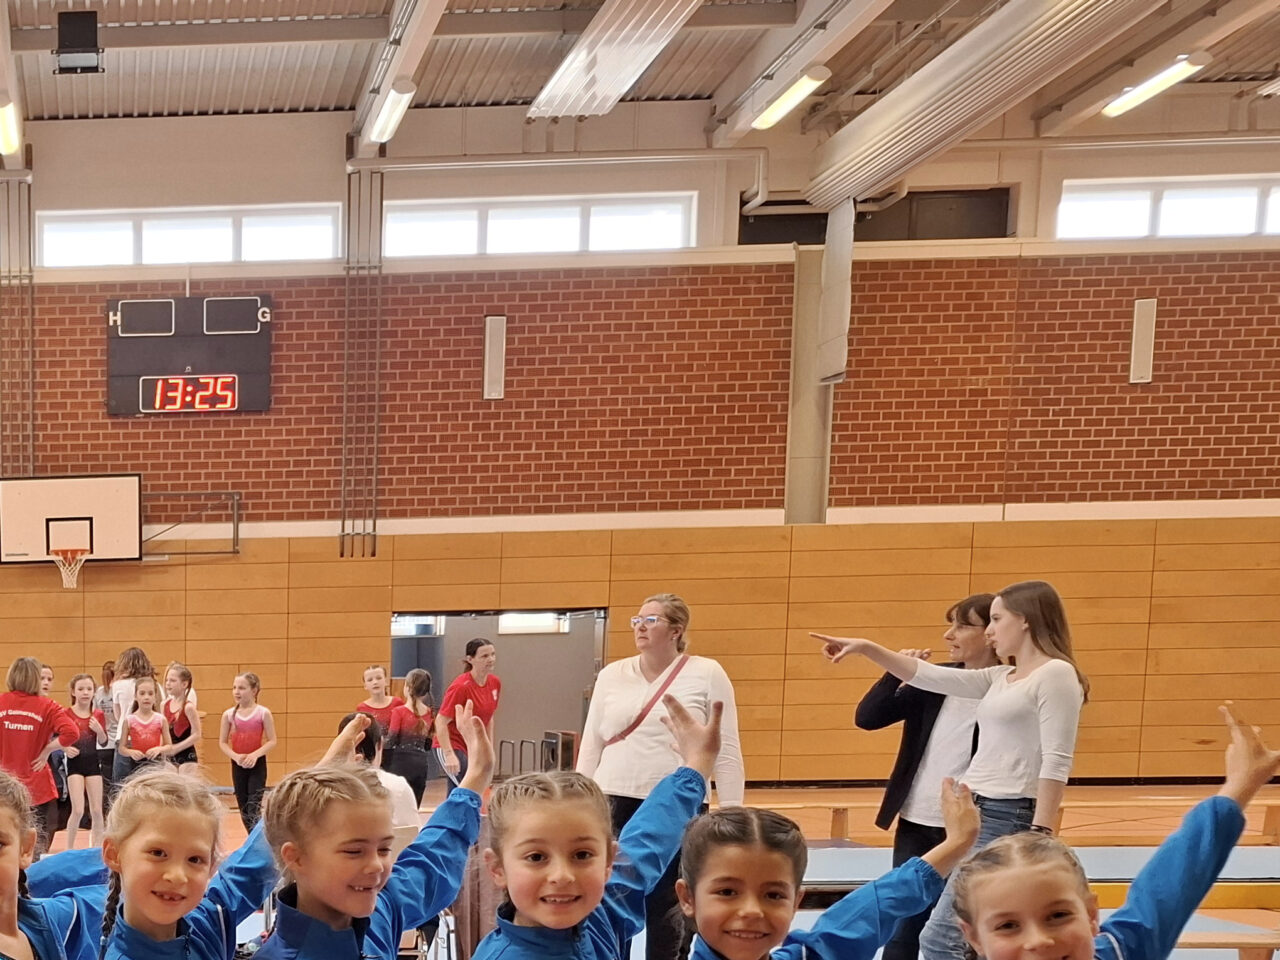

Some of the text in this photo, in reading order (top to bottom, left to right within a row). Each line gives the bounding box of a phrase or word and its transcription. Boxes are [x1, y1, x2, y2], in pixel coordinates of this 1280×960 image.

[108, 311, 121, 326] H
[257, 307, 270, 322] G
[154, 377, 234, 410] 13:25
[3, 720, 34, 731] Turnen
